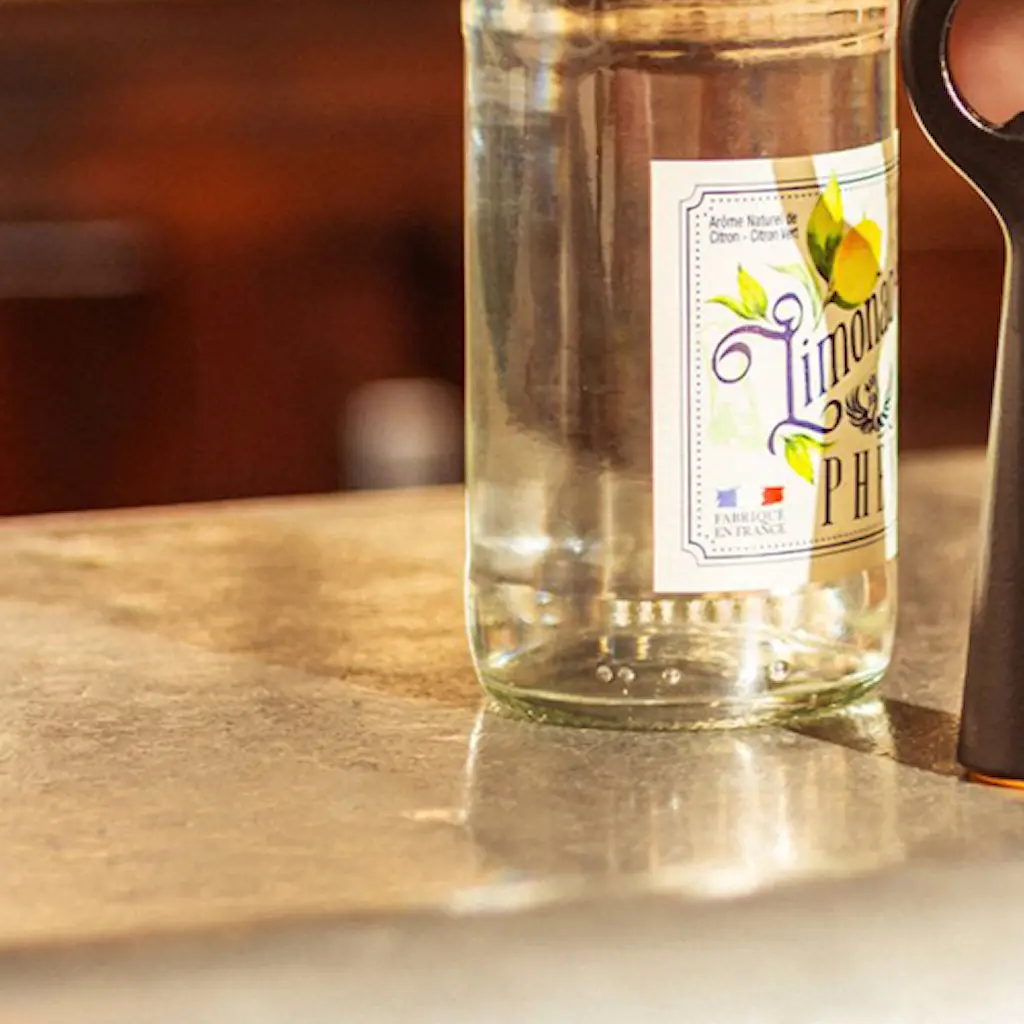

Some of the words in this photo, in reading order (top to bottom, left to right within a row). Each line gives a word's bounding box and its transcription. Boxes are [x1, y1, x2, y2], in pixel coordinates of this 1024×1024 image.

[786, 212, 798, 225] de
[709, 229, 740, 245] Citron
[714, 526, 733, 538] EN
[735, 523, 787, 537] FRANCE
